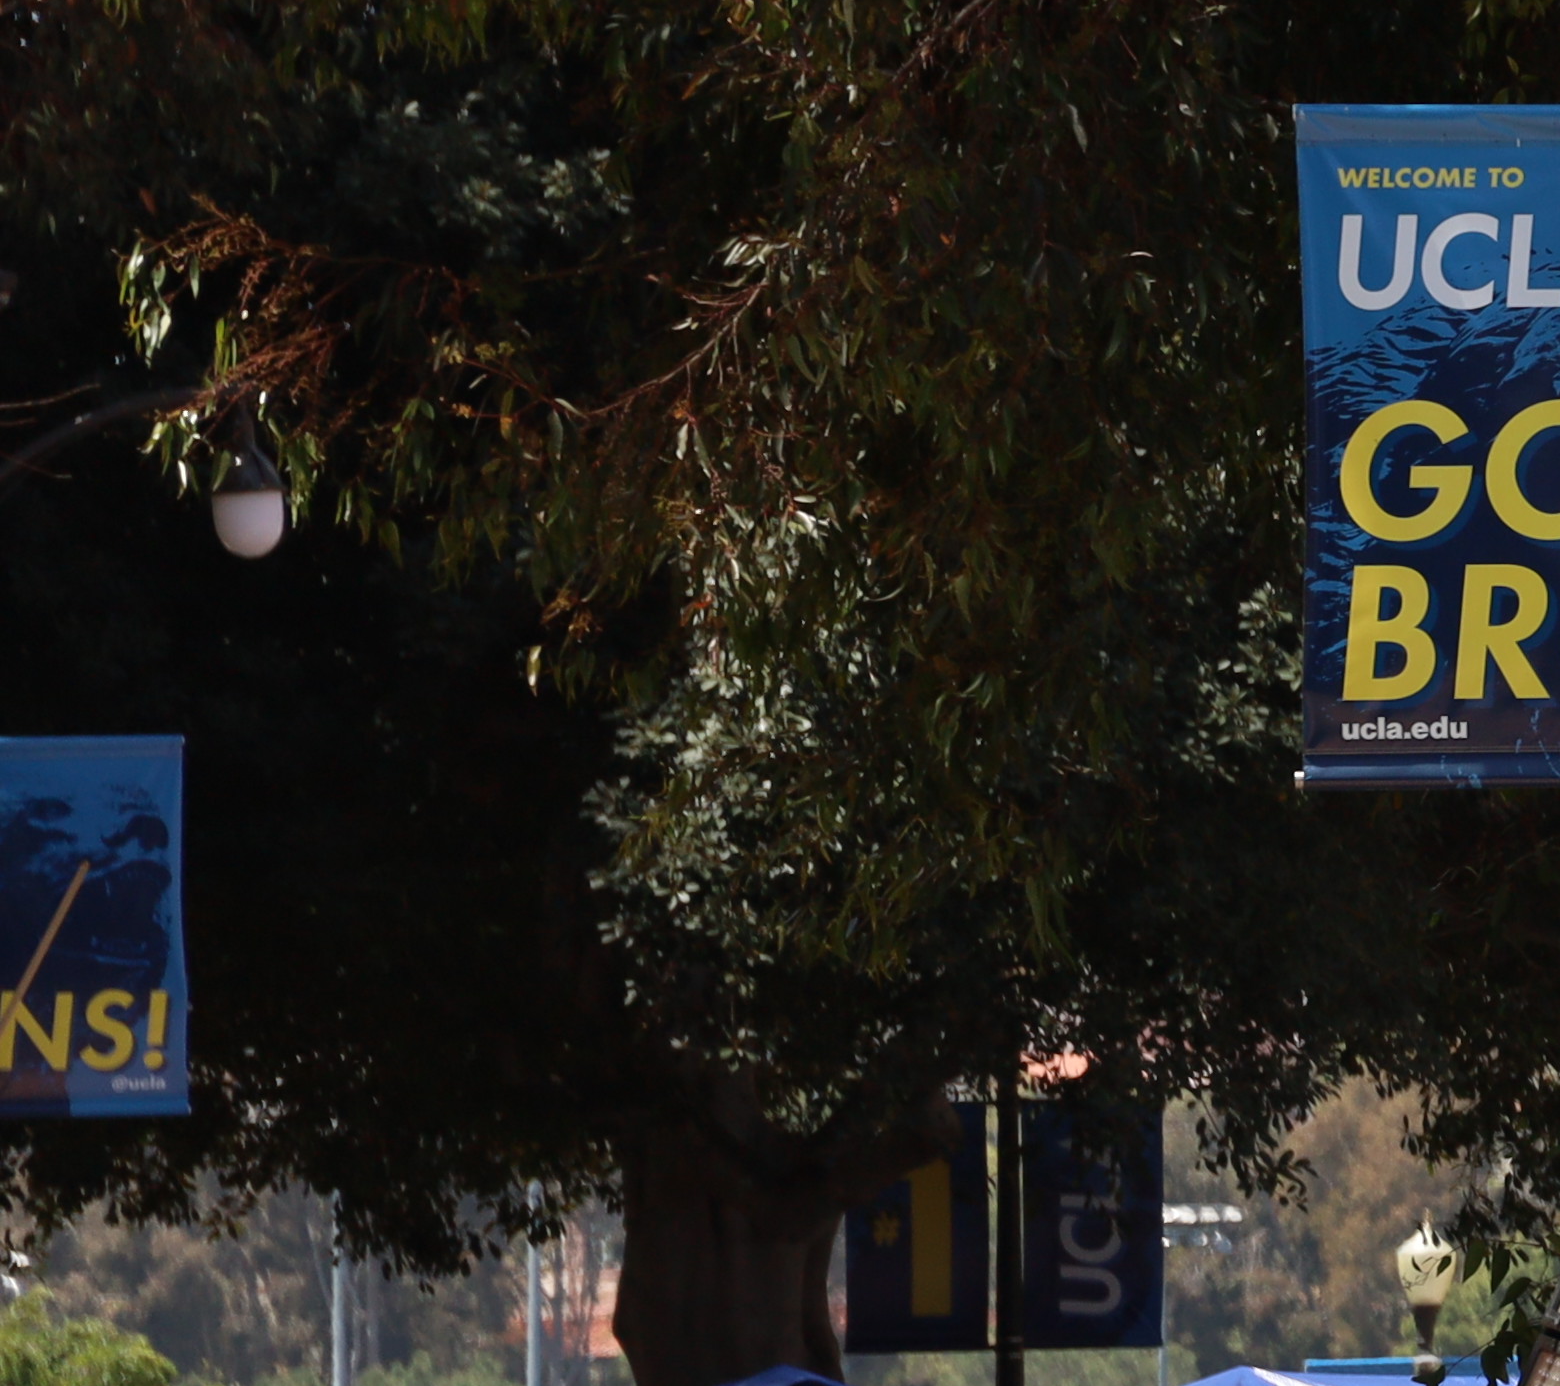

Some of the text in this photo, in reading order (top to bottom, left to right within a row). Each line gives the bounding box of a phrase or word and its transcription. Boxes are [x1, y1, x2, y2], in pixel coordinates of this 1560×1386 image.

[1338, 167, 1525, 188] WELCOME TO
[1341, 717, 1468, 742] ucla.edu
[111, 1075, 166, 1093] @ucla
